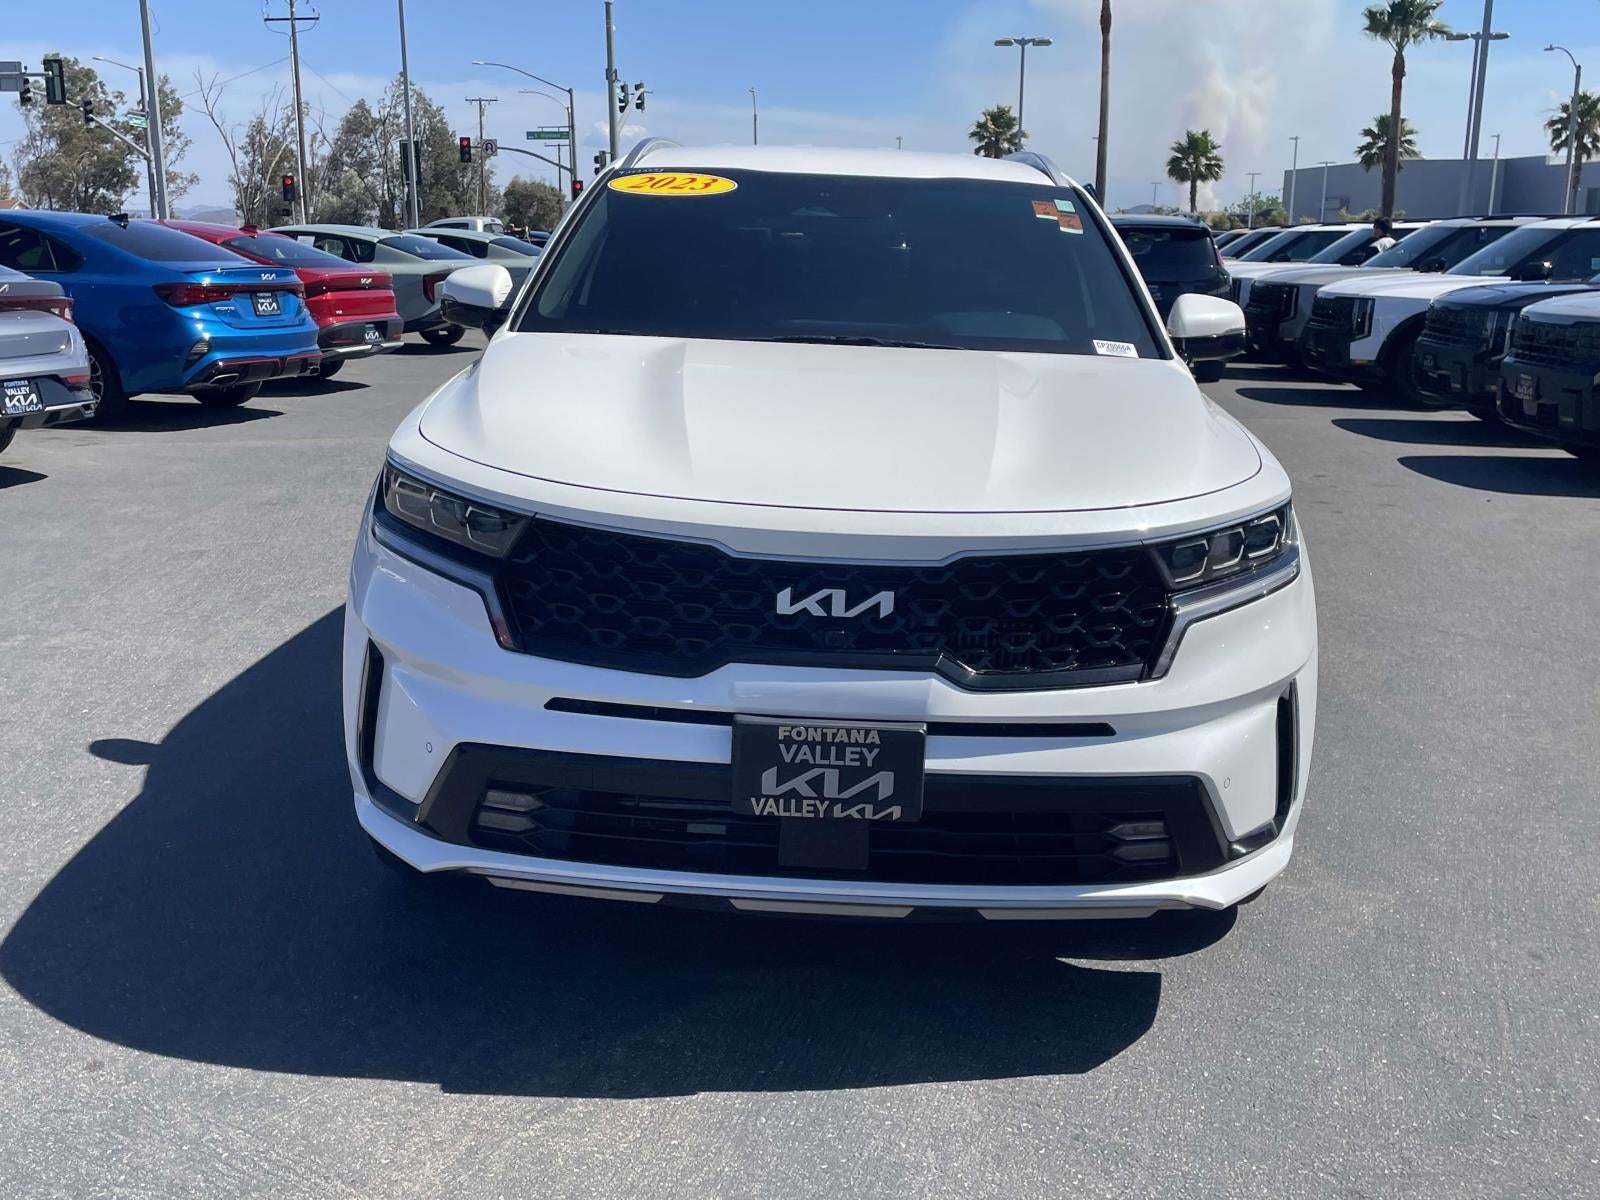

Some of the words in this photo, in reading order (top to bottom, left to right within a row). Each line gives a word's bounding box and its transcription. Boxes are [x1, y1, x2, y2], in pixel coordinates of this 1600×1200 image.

[628, 176, 719, 191] 2023
[257, 302, 278, 311] KIA
[5, 386, 30, 396] VALLEY
[5, 393, 37, 408] KIA
[777, 586, 895, 619] KIA
[778, 726, 881, 744] FONTANA
[779, 744, 881, 767] VALLEY
[761, 765, 895, 801] KIA
[750, 797, 830, 818] VALLEY
[833, 802, 902, 821] KIA
